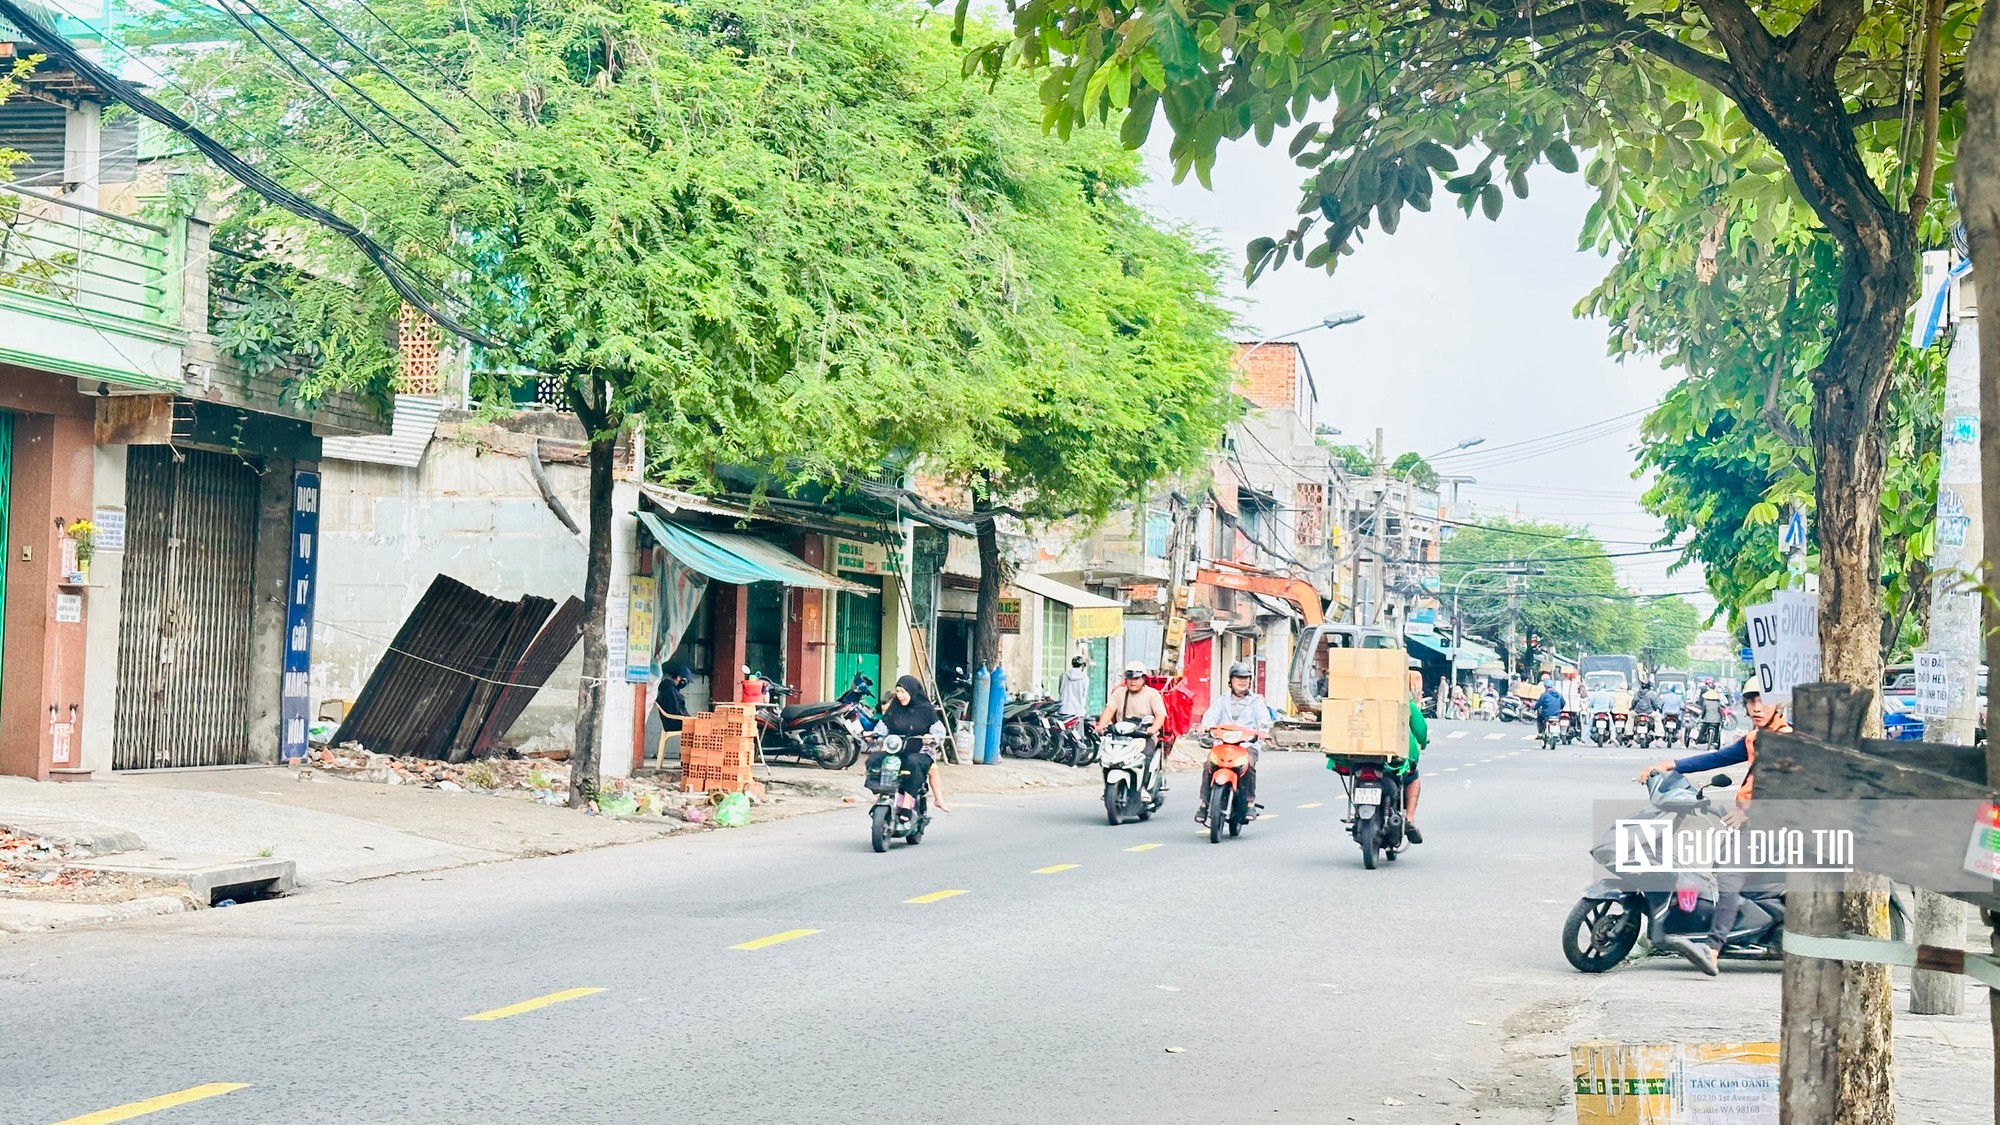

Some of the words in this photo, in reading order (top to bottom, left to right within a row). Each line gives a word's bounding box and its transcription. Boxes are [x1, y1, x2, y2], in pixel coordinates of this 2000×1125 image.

[296, 486, 317, 517] DỊCH
[299, 533, 311, 564] VỤ
[296, 574, 309, 604] KÝ
[291, 618, 307, 651] GỬI
[285, 666, 307, 697] HÀNG
[287, 713, 304, 744] HÓA
[1719, 1093, 1730, 1102] 1st
[1732, 1093, 1760, 1102] Avenue
[1761, 1092, 1767, 1101] S
[1720, 1079, 1739, 1089] KIM
[1741, 1078, 1770, 1088] OANH
[1720, 1105, 1734, 1114] WA
[1735, 1105, 1760, 1114] 98168
